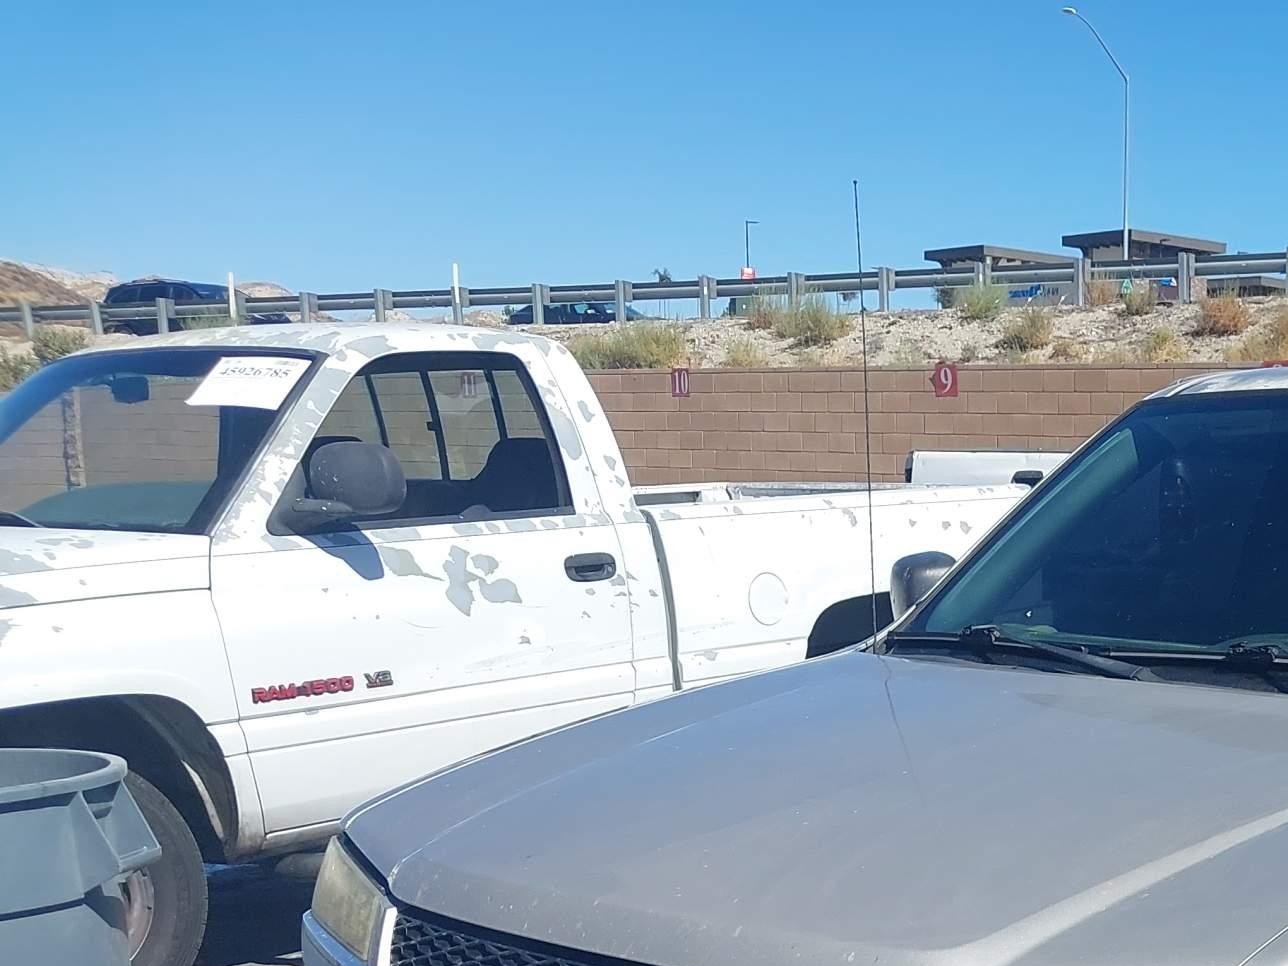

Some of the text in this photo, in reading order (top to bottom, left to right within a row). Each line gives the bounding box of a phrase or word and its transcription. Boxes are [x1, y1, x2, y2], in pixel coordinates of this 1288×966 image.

[219, 367, 292, 379] 45926785
[674, 370, 688, 394] 10
[940, 367, 953, 393] 9
[302, 676, 354, 697] 1500
